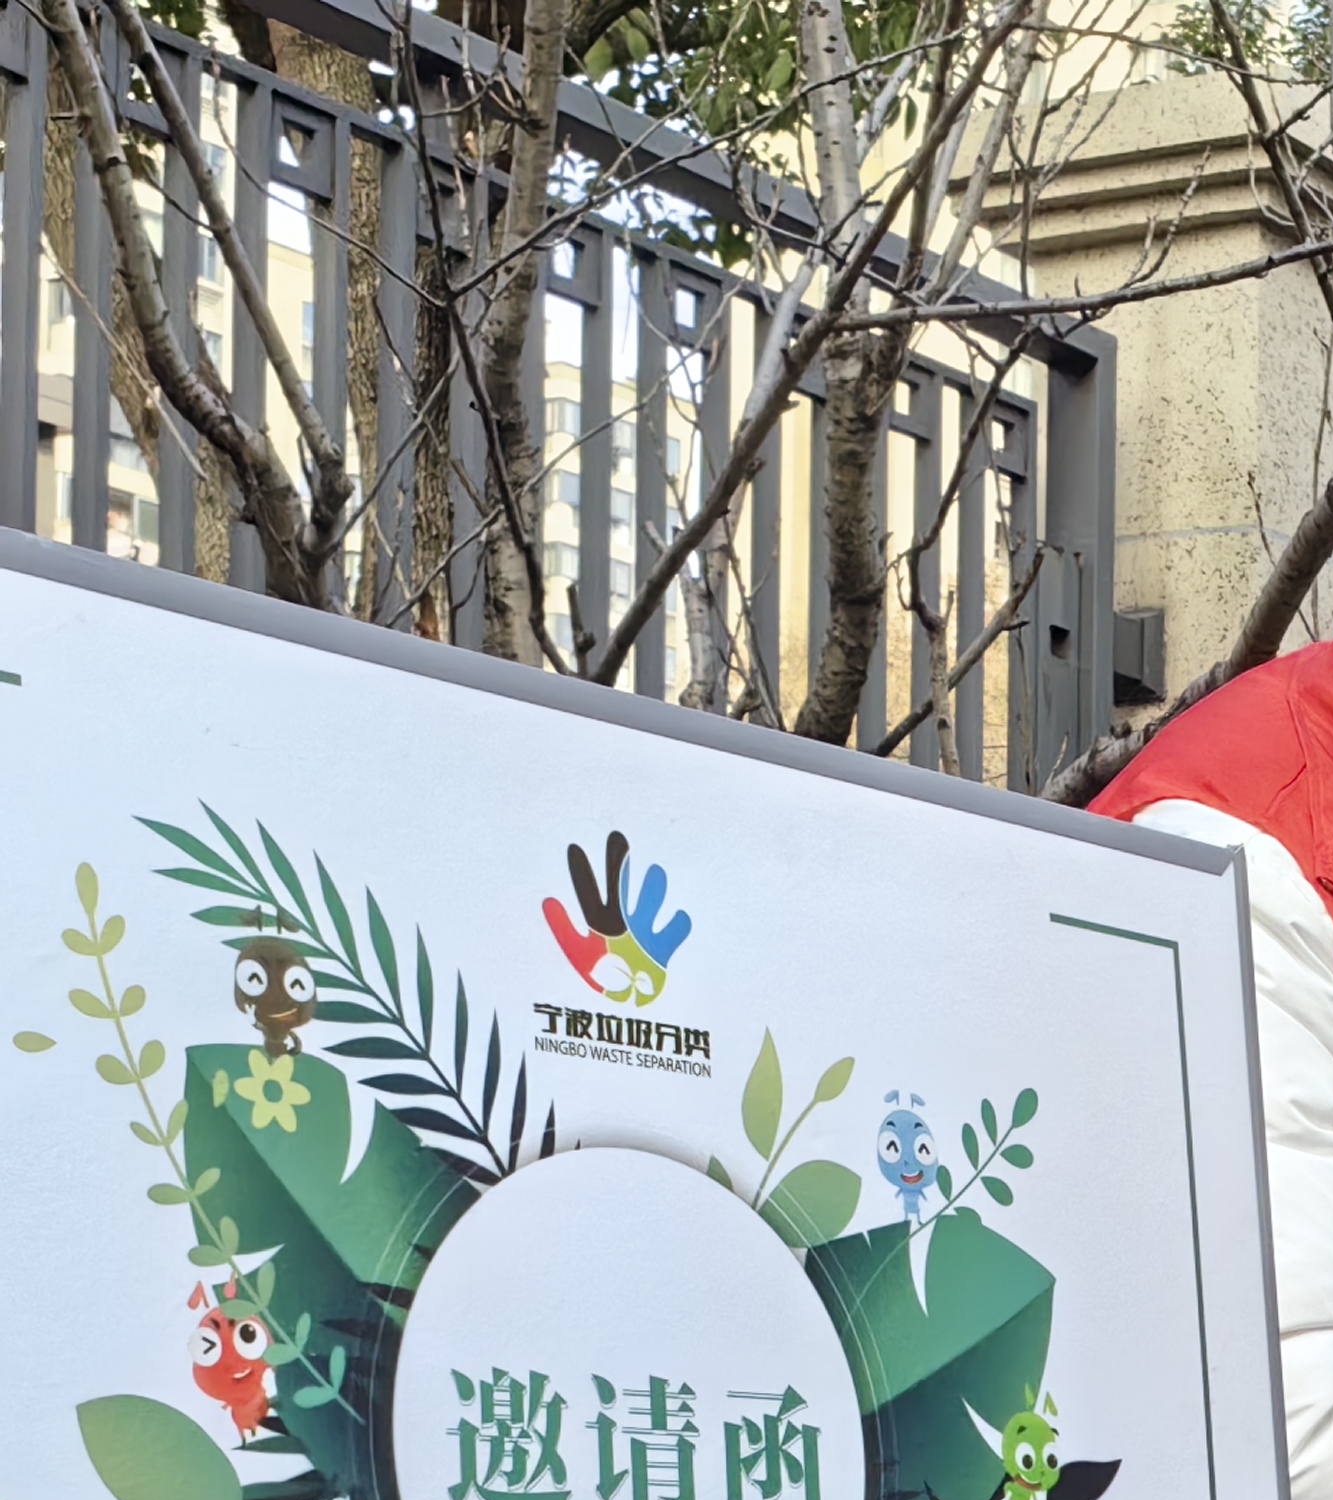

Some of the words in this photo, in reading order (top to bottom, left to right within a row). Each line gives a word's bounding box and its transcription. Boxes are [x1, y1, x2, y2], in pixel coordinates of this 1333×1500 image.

[534, 1036, 588, 1058] NINGBO
[589, 1045, 634, 1067] WASTE
[635, 1053, 712, 1078] SEPARATION
